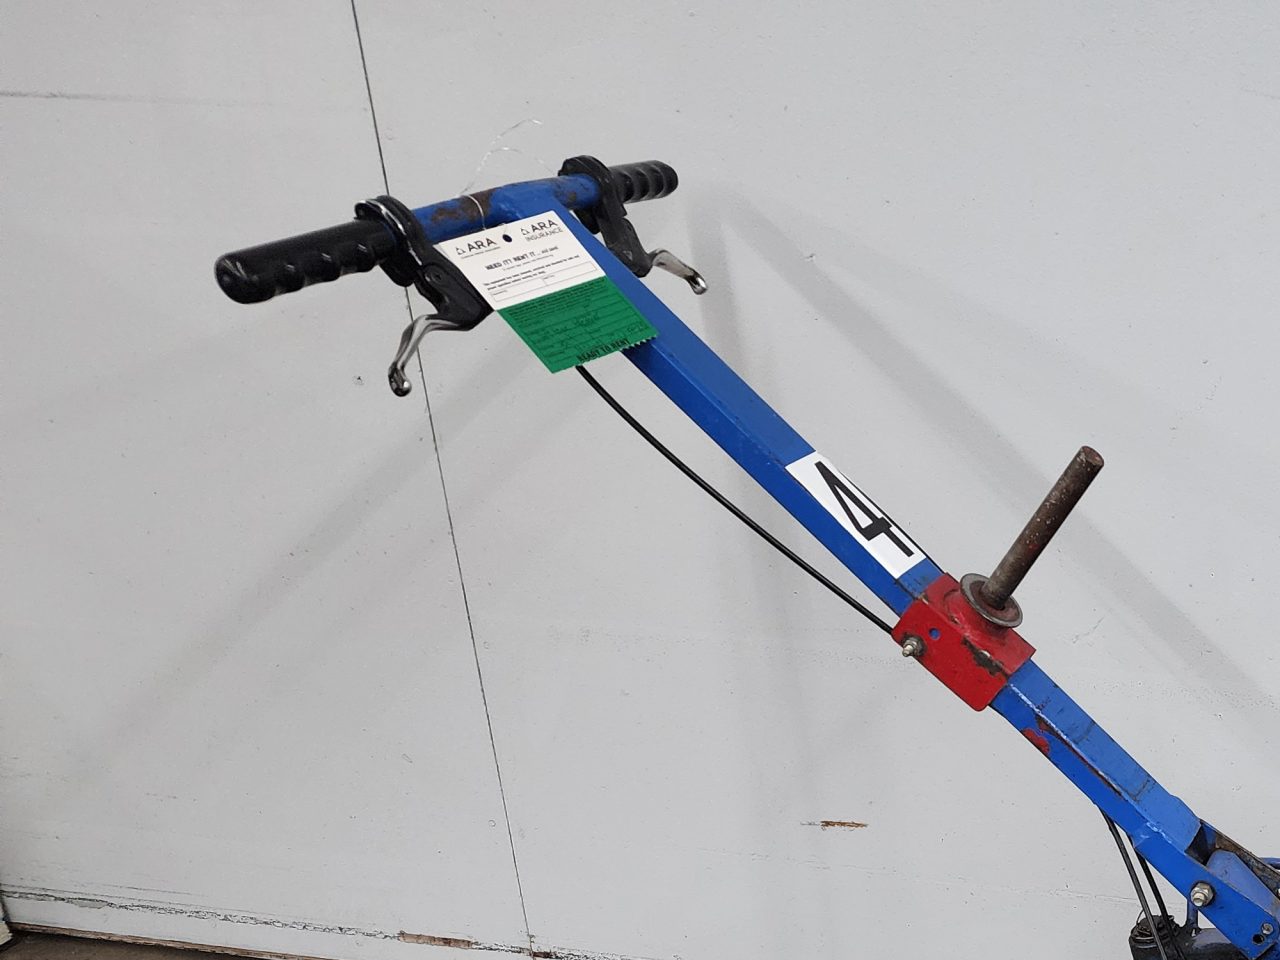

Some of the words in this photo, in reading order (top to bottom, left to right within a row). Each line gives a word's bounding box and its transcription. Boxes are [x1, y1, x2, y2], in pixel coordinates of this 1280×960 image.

[531, 219, 558, 232] ARA
[525, 227, 564, 241] INSURANCE
[467, 237, 498, 252] ARA
[814, 460, 915, 558] 4
